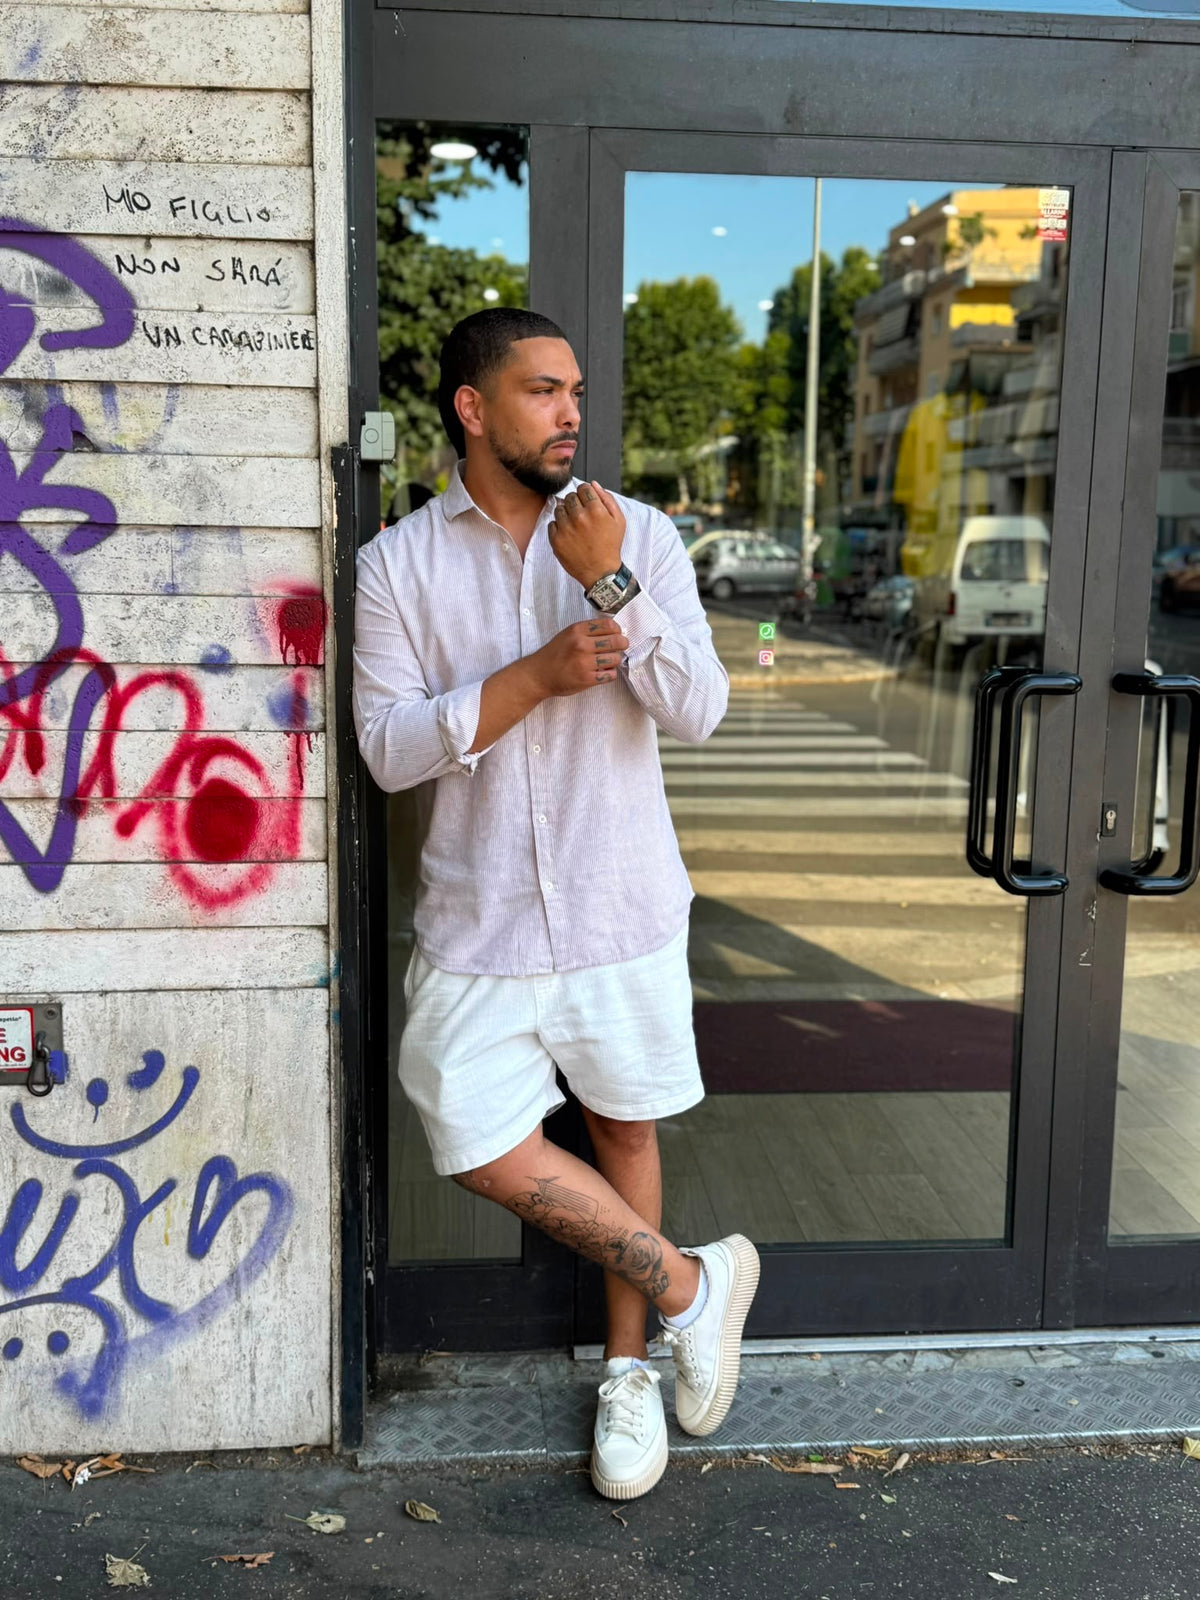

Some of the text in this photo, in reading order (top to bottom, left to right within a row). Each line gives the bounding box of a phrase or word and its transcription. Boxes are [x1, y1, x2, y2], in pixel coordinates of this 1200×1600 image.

[103, 183, 271, 225] MIO FIGLIO
[115, 254, 180, 275] NON
